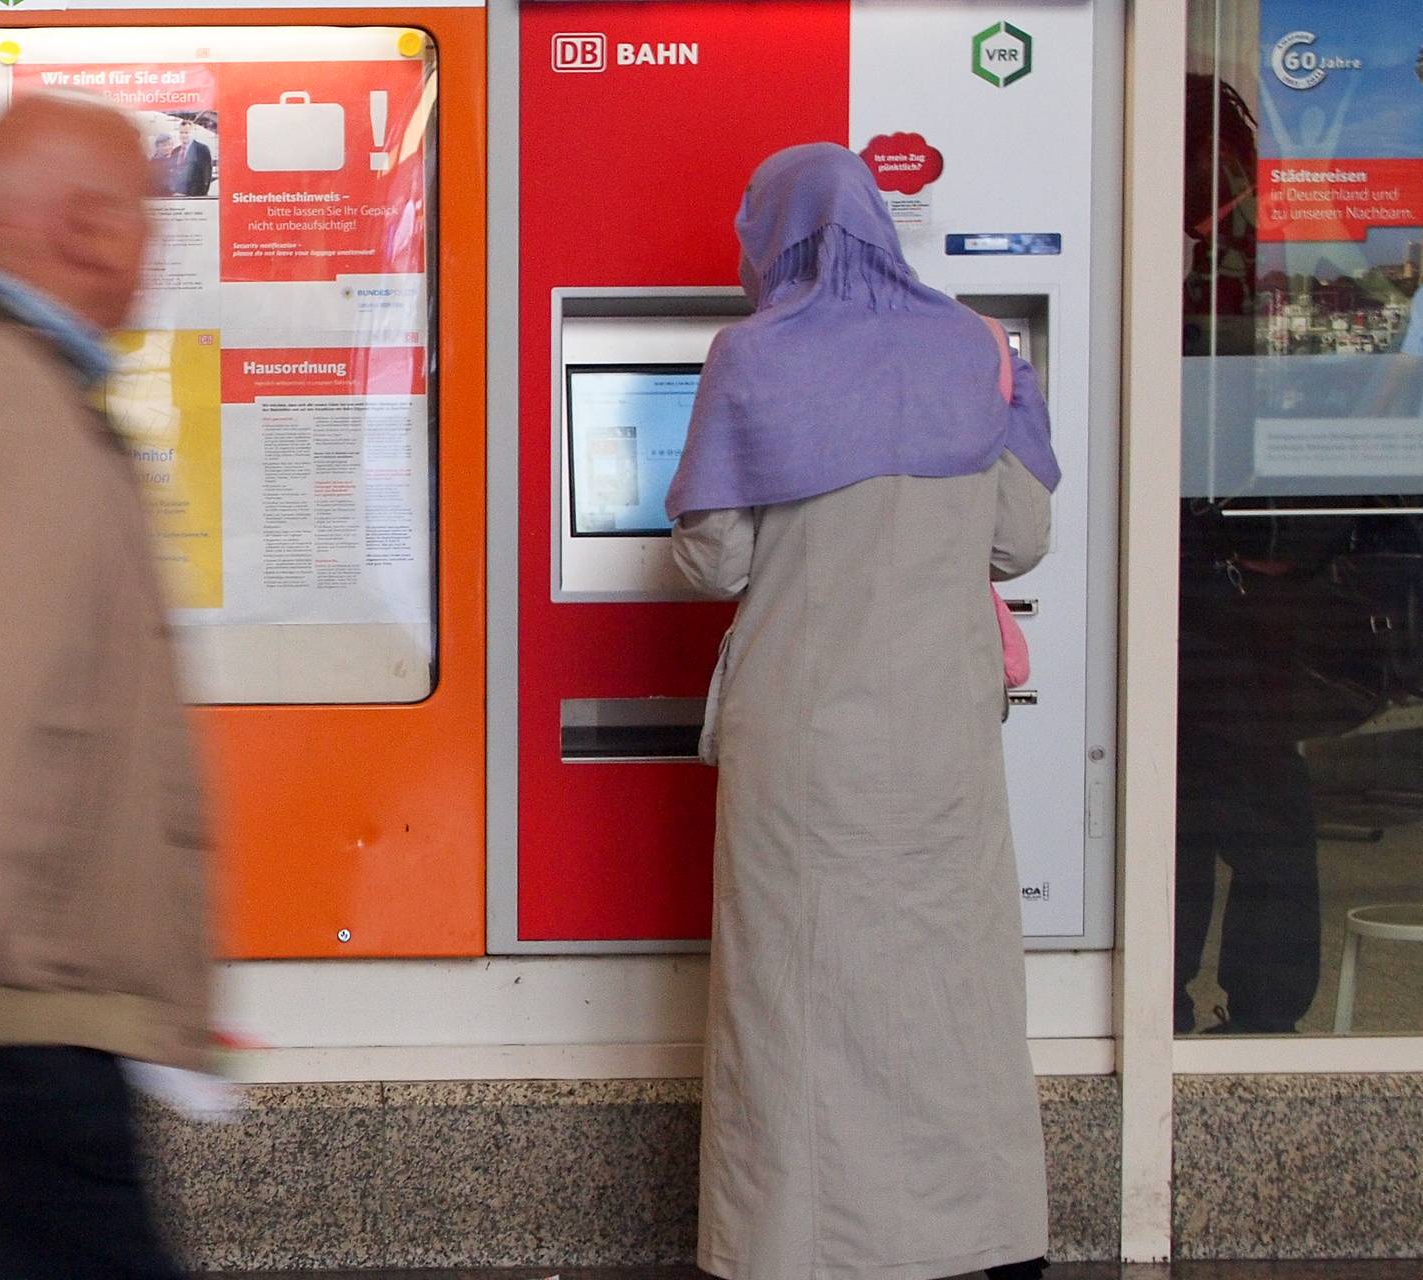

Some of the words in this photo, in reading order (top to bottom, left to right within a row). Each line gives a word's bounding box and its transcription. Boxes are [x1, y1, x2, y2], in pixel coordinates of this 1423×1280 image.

[559, 39, 600, 67] DB
[616, 43, 699, 65] BAHN
[985, 49, 1018, 61] VRR
[1285, 52, 1316, 70] 60
[1319, 56, 1362, 68] Jahre
[41, 72, 69, 84] Wir
[73, 71, 105, 84] sind
[108, 71, 132, 84] für
[135, 71, 157, 84] Sie
[161, 71, 185, 84] da!
[1270, 168, 1367, 183] Städtereisen
[232, 192, 341, 203] Sicherheitshinweis
[1286, 187, 1369, 201] Deutschland
[1372, 187, 1400, 201] und
[267, 206, 291, 217] bitte
[293, 205, 325, 216] lassen
[326, 205, 342, 216] Sie
[344, 205, 358, 216] Ihr
[248, 220, 274, 231] nicht
[276, 220, 357, 233] unbeaufsichtigt!
[243, 361, 347, 376] Hausordnung
